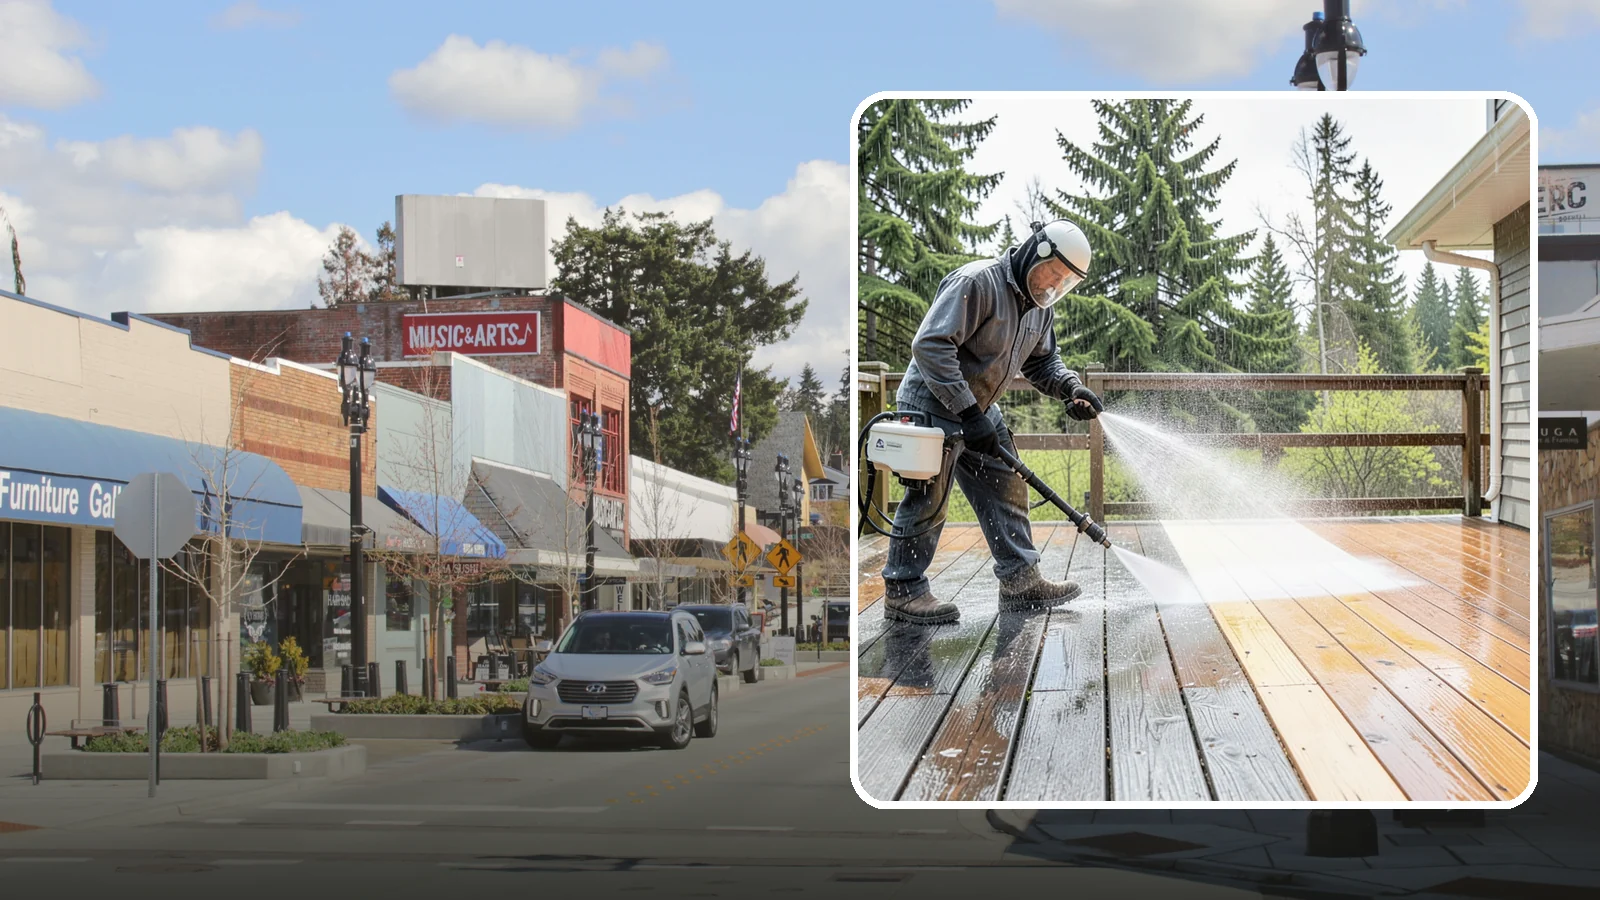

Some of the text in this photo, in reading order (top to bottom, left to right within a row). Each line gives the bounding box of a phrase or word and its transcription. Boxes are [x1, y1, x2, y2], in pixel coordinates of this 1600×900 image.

[409, 323, 518, 348] MUSIC&ARTS
[0, 471, 122, 519] Furniture Gal
[454, 562, 479, 575] SUSHI
